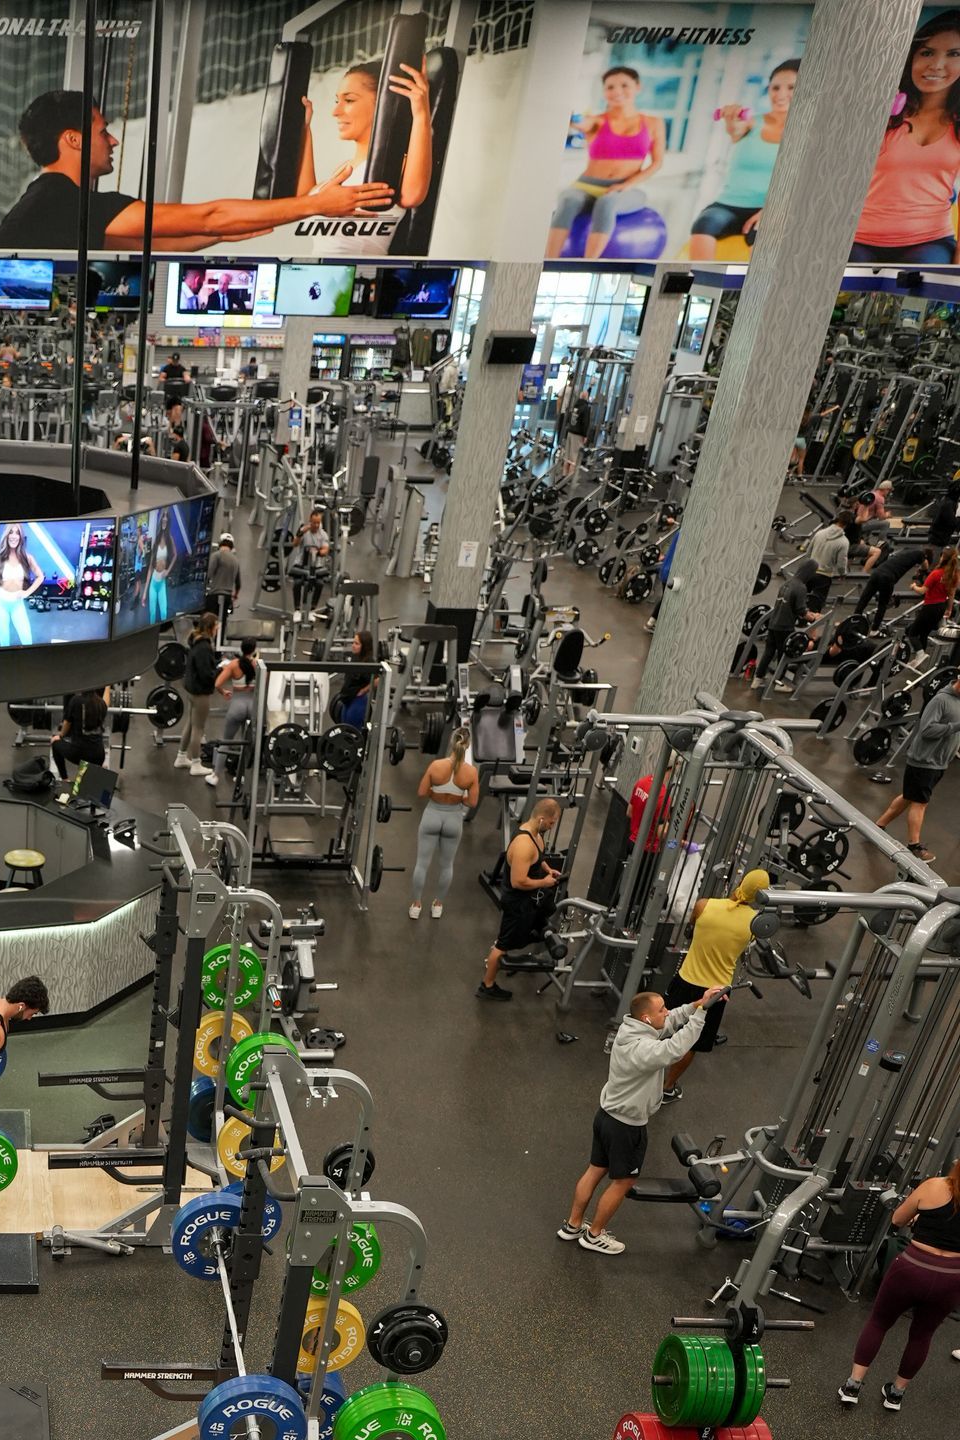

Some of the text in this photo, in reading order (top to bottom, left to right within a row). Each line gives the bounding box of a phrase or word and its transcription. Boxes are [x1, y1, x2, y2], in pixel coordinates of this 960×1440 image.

[47, 19, 143, 38] TRANING
[606, 26, 755, 46] GROUP FITNESS
[294, 221, 397, 237] UNIQUE
[195, 1026, 216, 1068] ROGUE
[180, 1210, 232, 1246] ROGUE
[183, 1251, 195, 1263] 45
[349, 1231, 373, 1268] OGUE
[344, 1275, 359, 1288] 25
[124, 1372, 193, 1380] HAMMER STRENGTH
[222, 1398, 293, 1421] ROGUE
[209, 1423, 225, 1432] 45
[400, 1412, 413, 1426] 25
